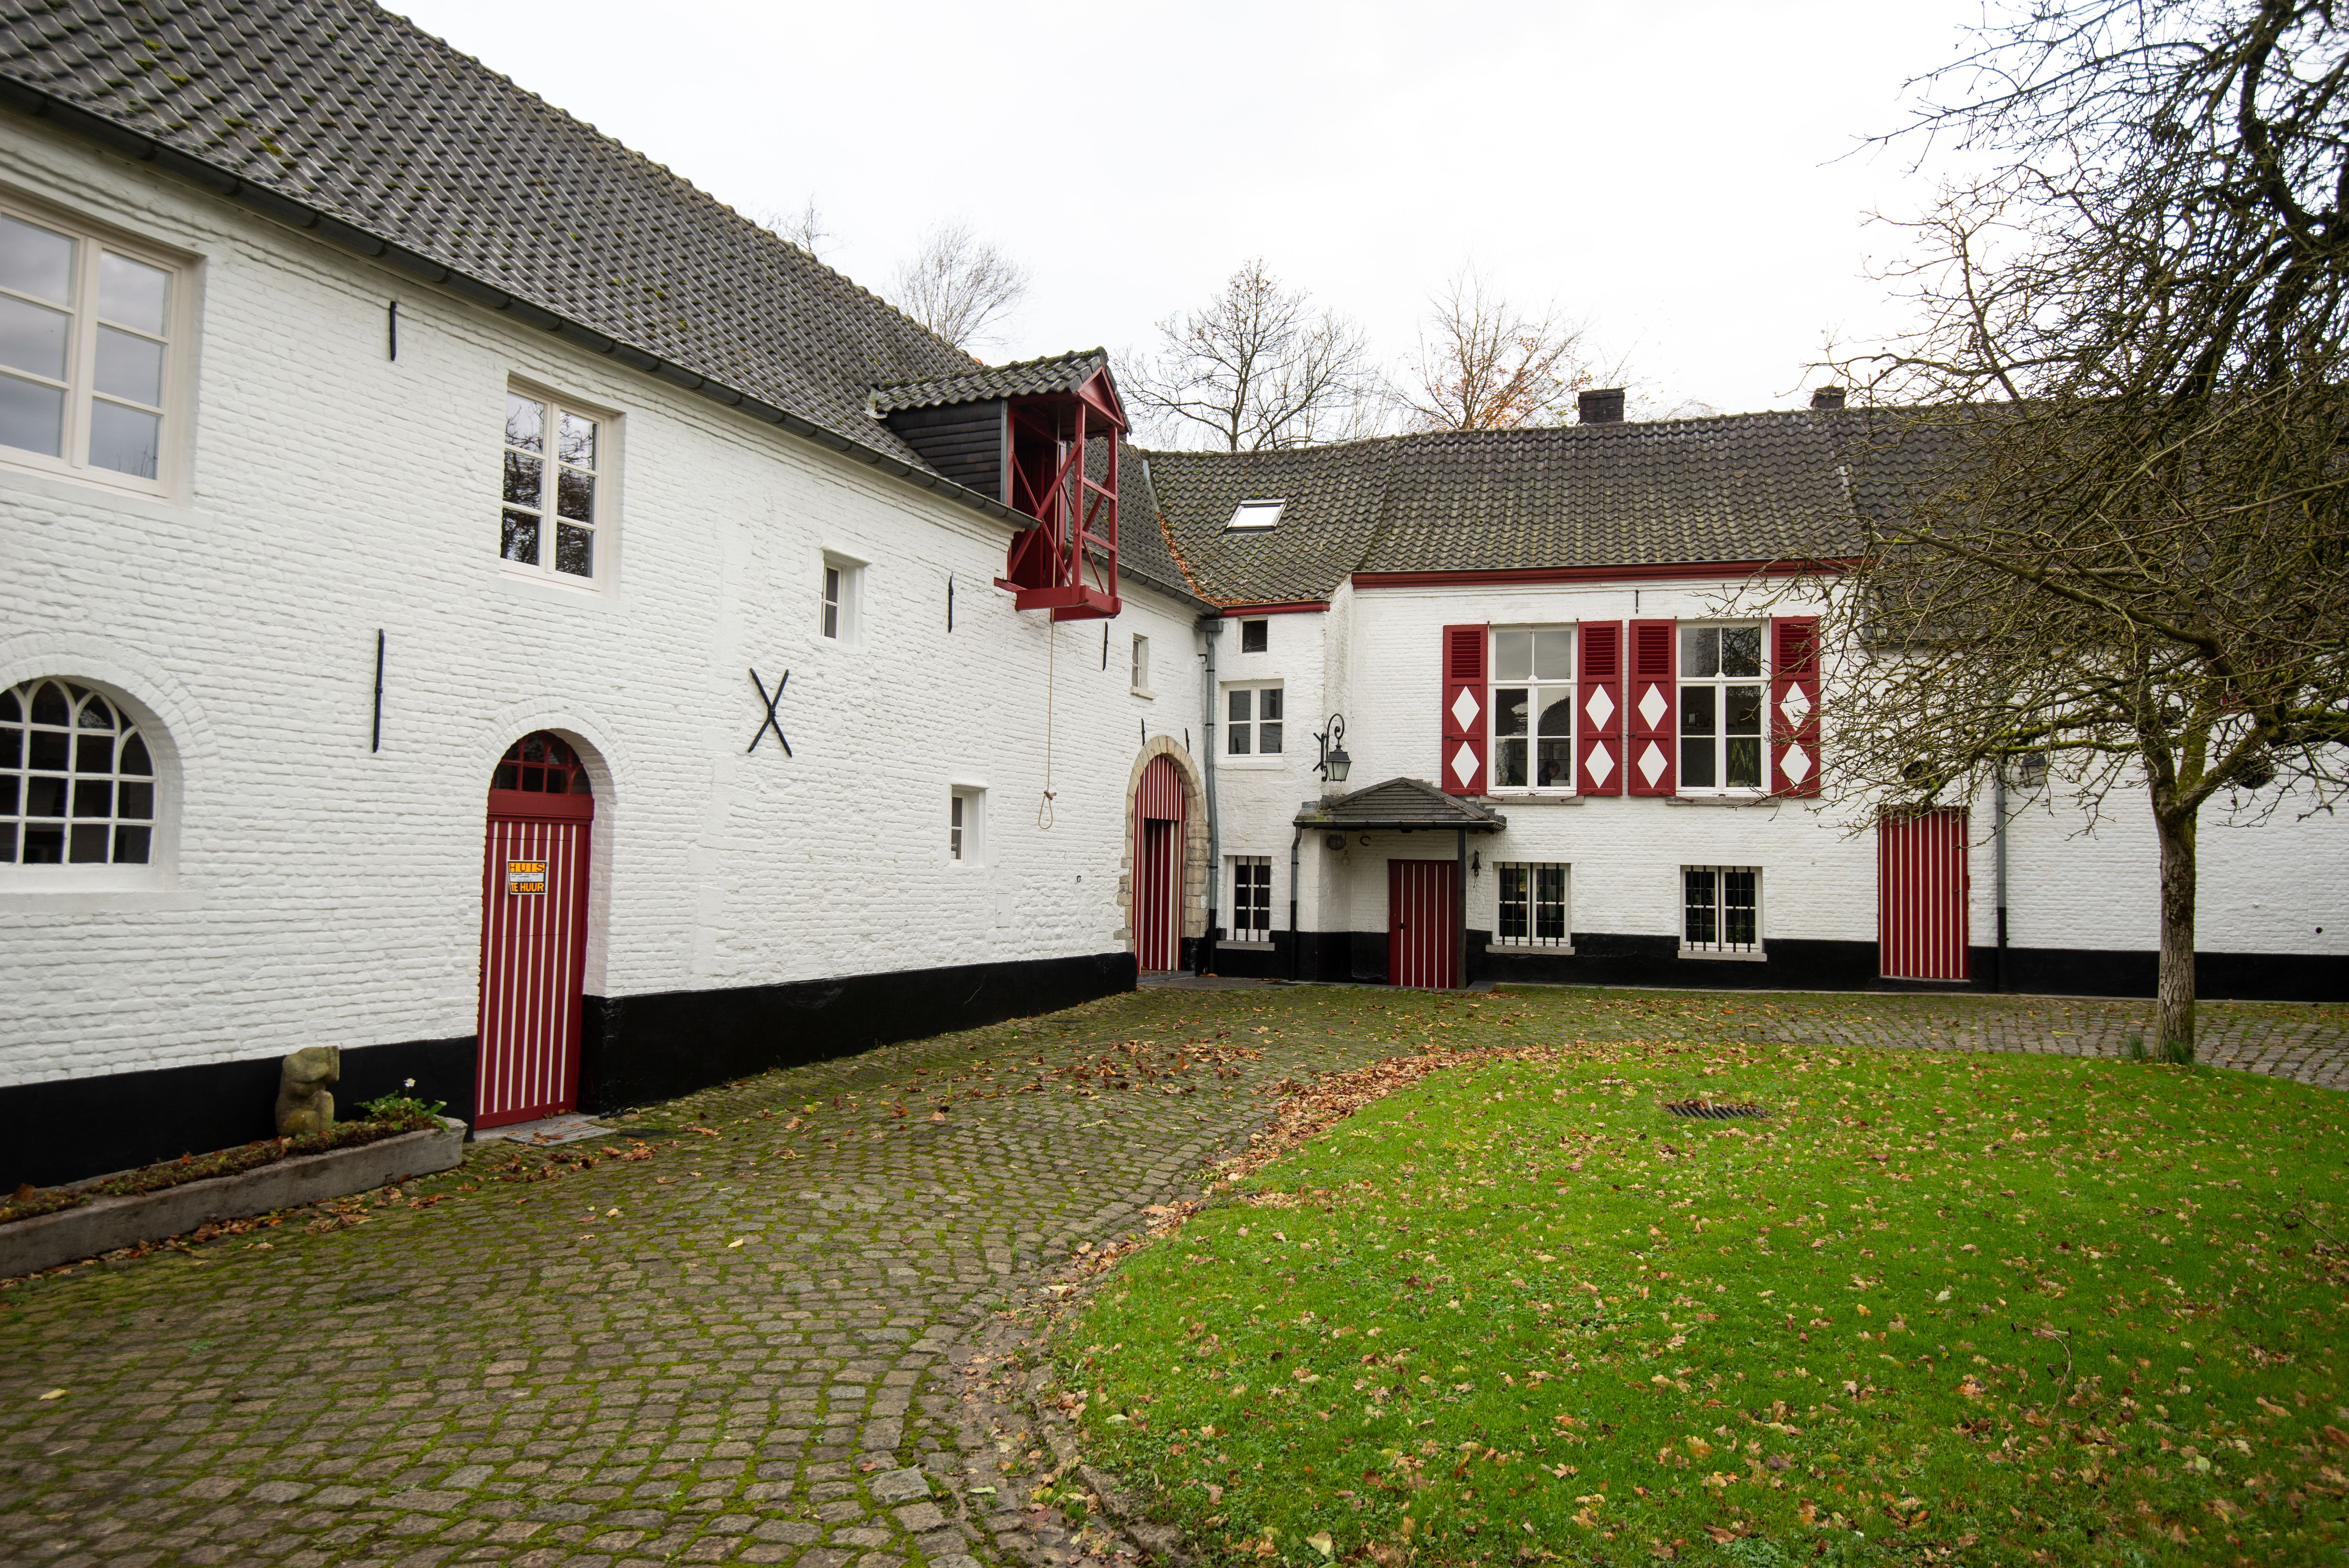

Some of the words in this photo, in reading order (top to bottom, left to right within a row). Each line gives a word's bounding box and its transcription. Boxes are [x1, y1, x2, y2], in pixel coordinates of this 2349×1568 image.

[510, 863, 544, 872] HUIS
[510, 882, 519, 892] TE
[520, 882, 544, 892] HUUR
